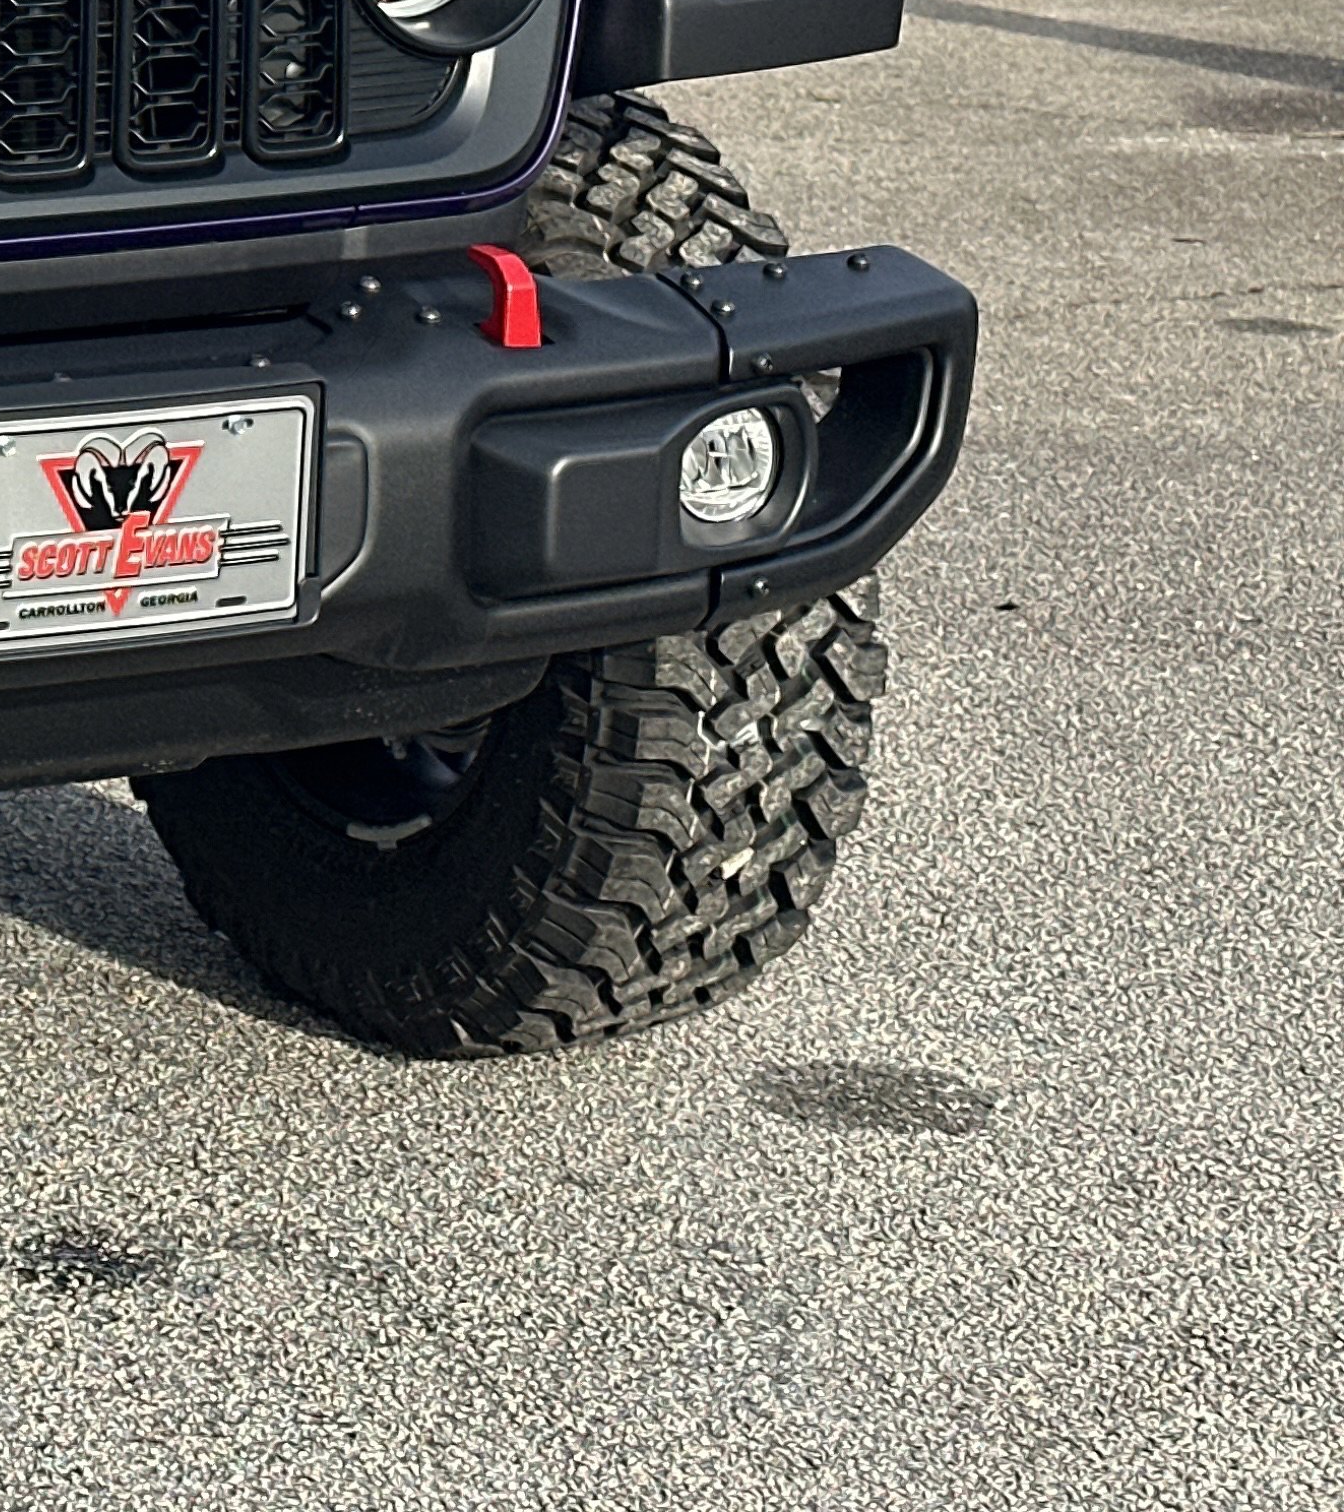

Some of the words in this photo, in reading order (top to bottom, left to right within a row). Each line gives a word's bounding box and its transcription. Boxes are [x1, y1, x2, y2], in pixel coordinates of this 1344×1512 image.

[16, 537, 114, 581] SCOTT
[114, 511, 217, 579] EVANS
[18, 601, 106, 620] CARROLLTON
[140, 591, 199, 607] GEORGIA
